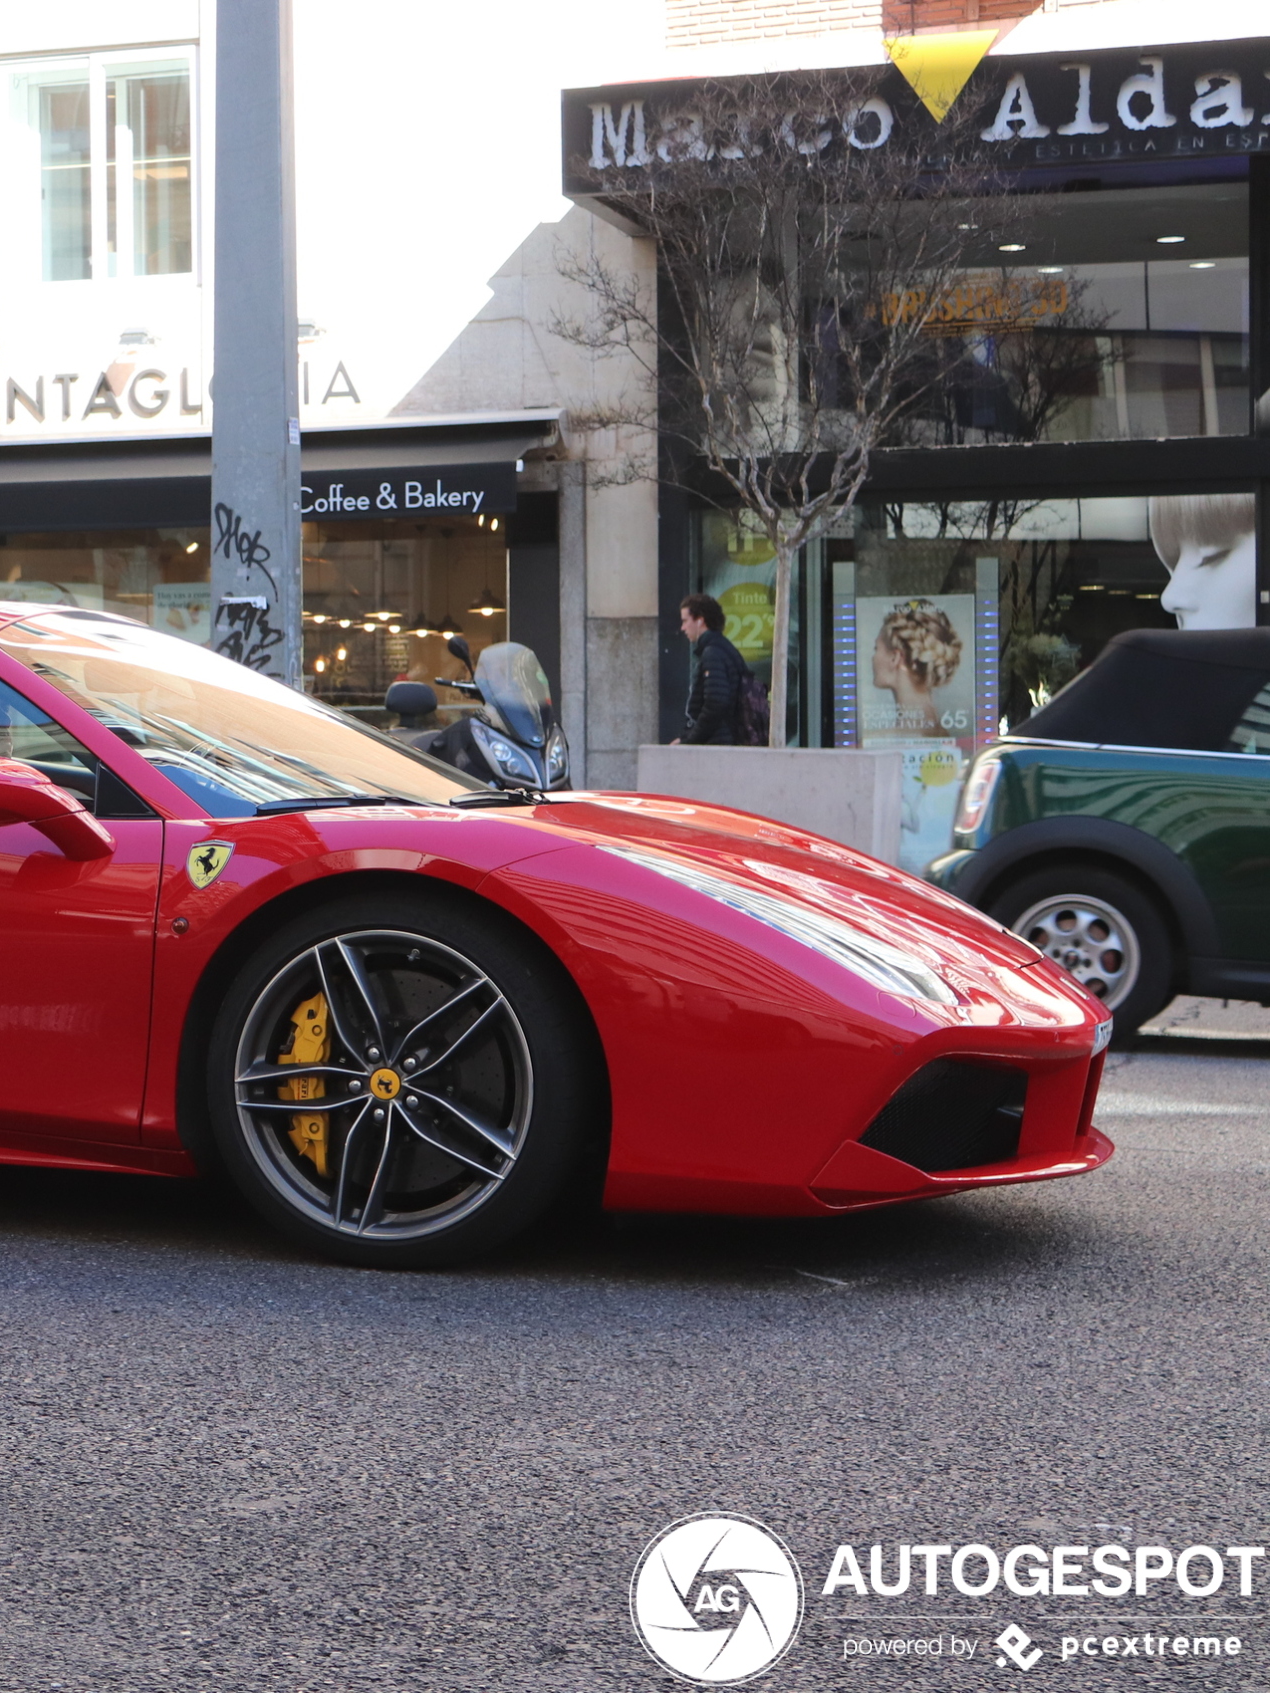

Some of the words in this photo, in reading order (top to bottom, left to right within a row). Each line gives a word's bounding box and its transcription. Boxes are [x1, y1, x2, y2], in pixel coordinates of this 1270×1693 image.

[588, 98, 894, 170] Marco
[980, 54, 1270, 142] Alda
[301, 483, 370, 513] Coffee
[376, 482, 397, 509] &
[405, 479, 484, 513] Bakery
[734, 591, 768, 605] Tinte
[940, 710, 969, 730] 65
